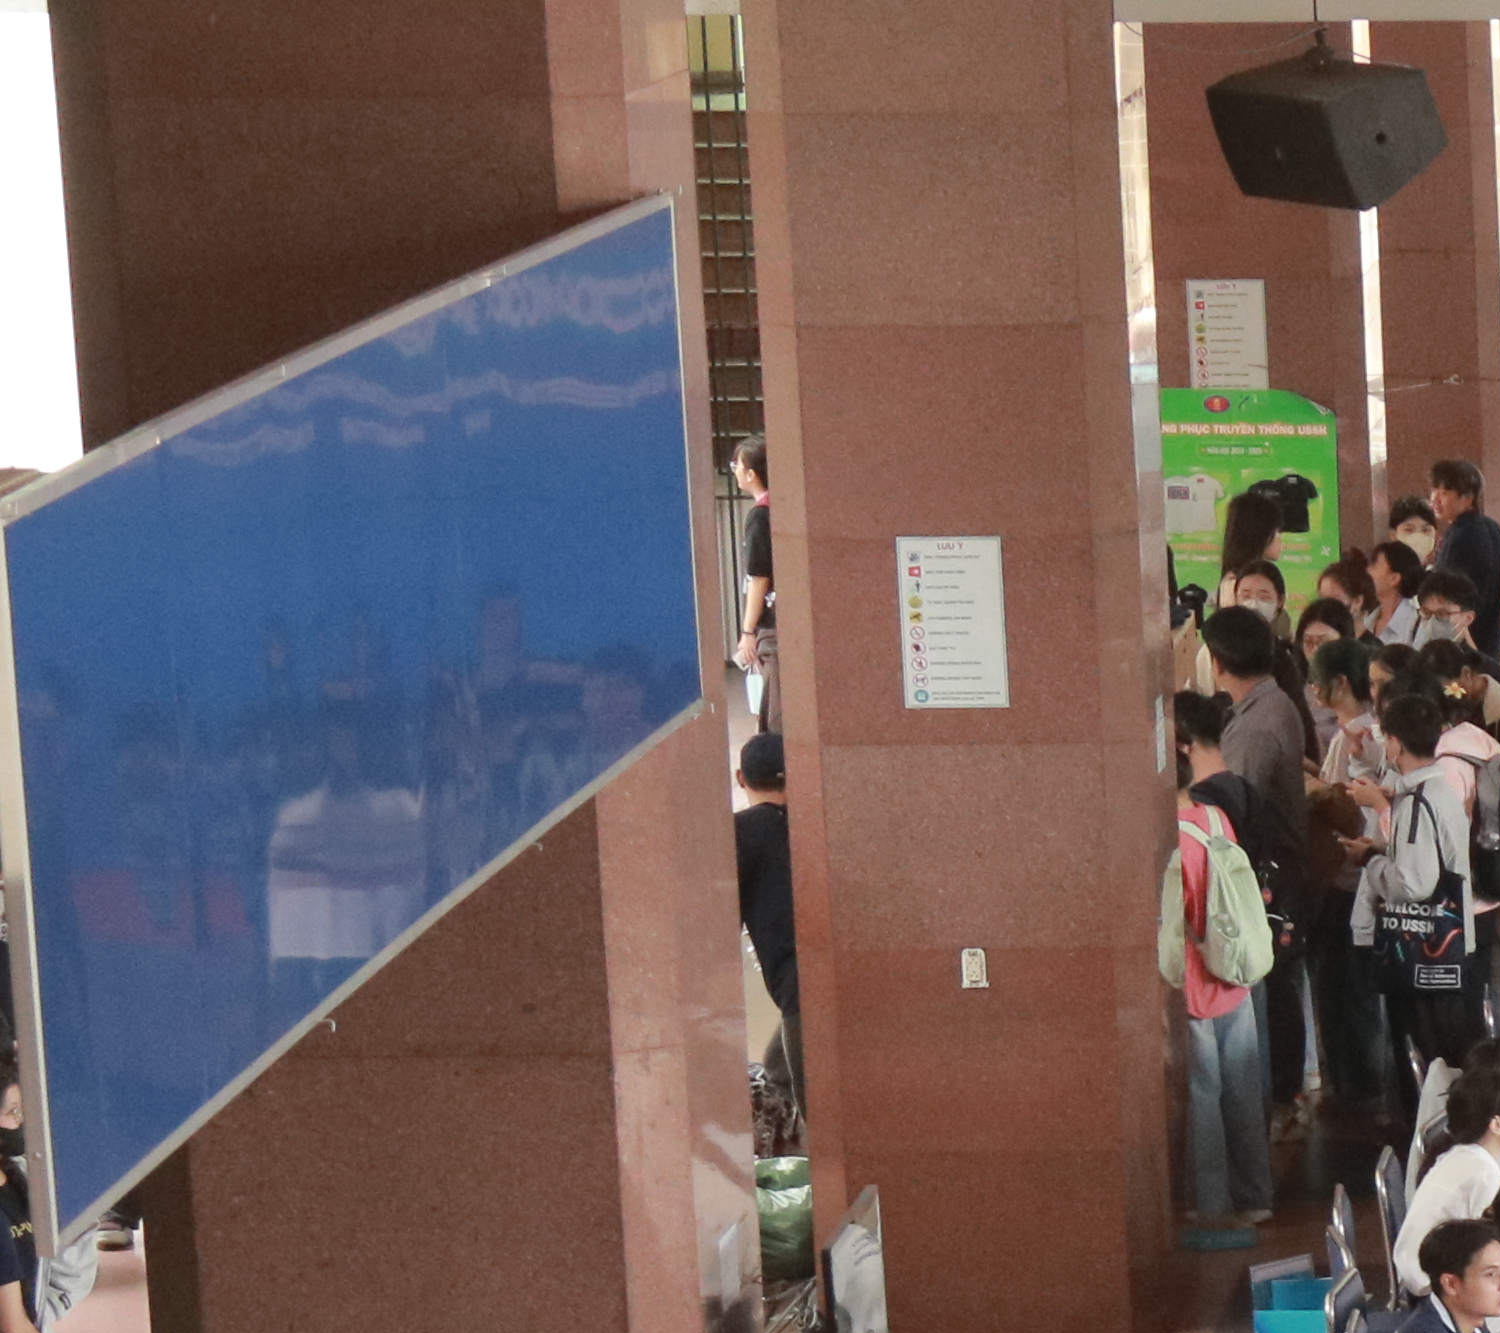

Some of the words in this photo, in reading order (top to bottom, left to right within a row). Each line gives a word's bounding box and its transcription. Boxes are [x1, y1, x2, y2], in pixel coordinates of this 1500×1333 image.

[1161, 424, 1177, 433] NG
[1381, 902, 1444, 917] WELCOE
[1383, 917, 1399, 930] TO
